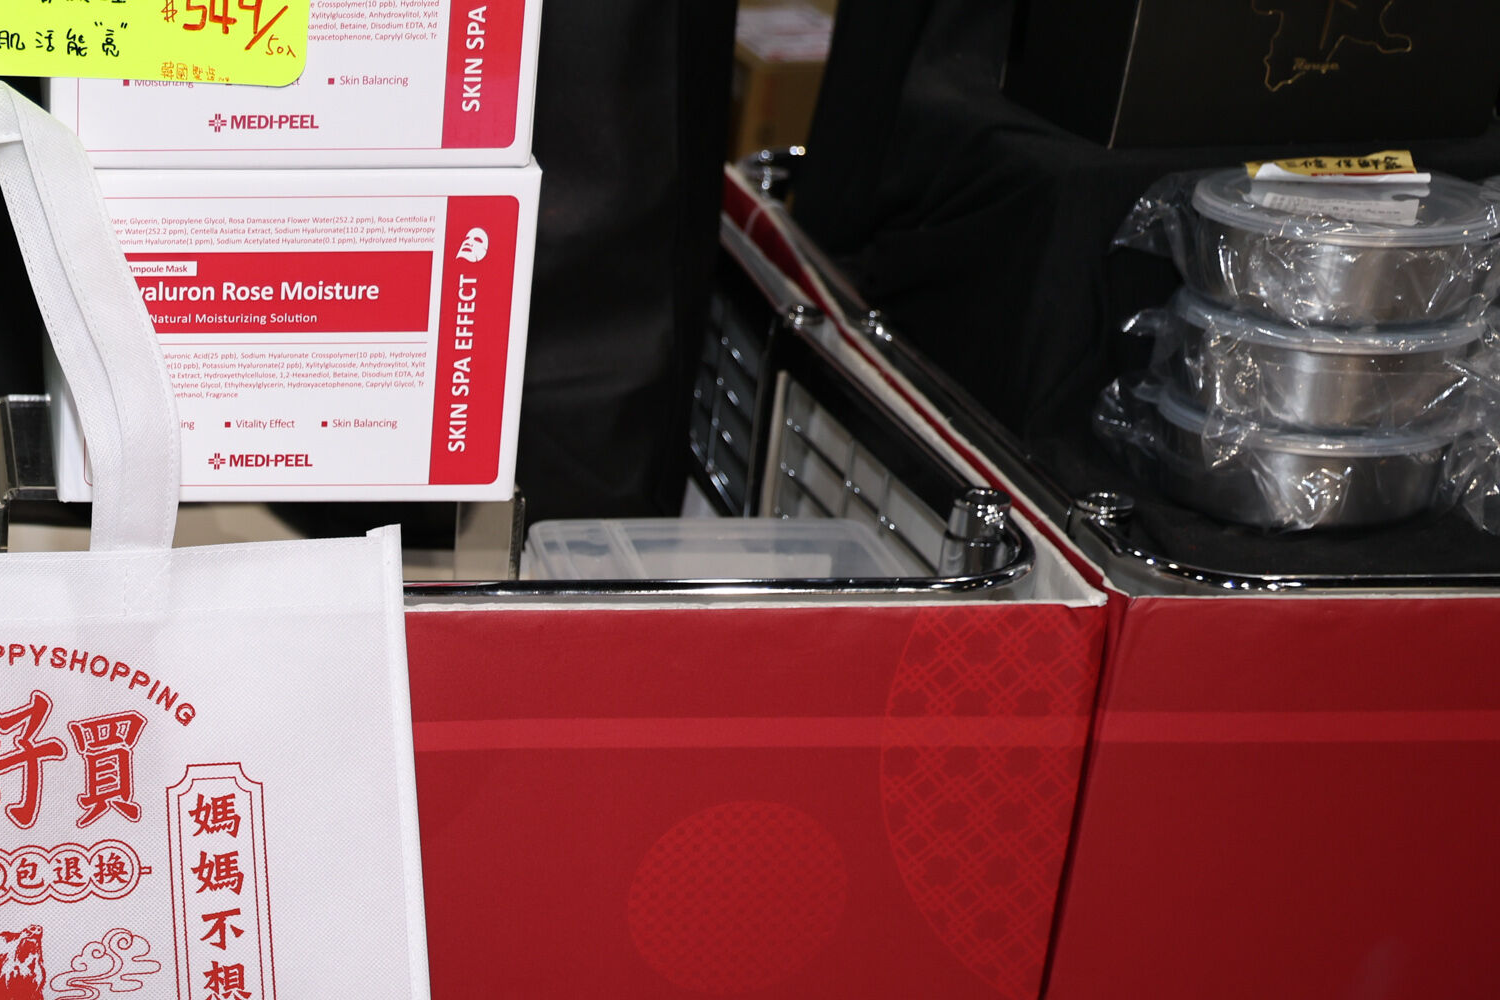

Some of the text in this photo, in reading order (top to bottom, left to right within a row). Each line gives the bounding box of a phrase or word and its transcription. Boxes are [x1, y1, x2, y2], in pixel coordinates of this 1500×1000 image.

[400, 0, 440, 8] Hydrolyzed
[371, 22, 403, 30] Disodium
[462, 6, 487, 112] SKIN SPA
[340, 75, 409, 86] Skin Balancing
[230, 115, 319, 130] MEDI-PEEL
[166, 264, 188, 274] Mask
[222, 281, 274, 301] Rose
[280, 280, 380, 301] Moisture
[150, 313, 318, 326] Natural Moisturizing Solution
[448, 274, 477, 452] SKIN SPA EFFECT
[236, 419, 295, 430] Vitality Effect
[332, 418, 398, 430] Skin Balancing
[229, 453, 313, 468] MEDI-PEEL
